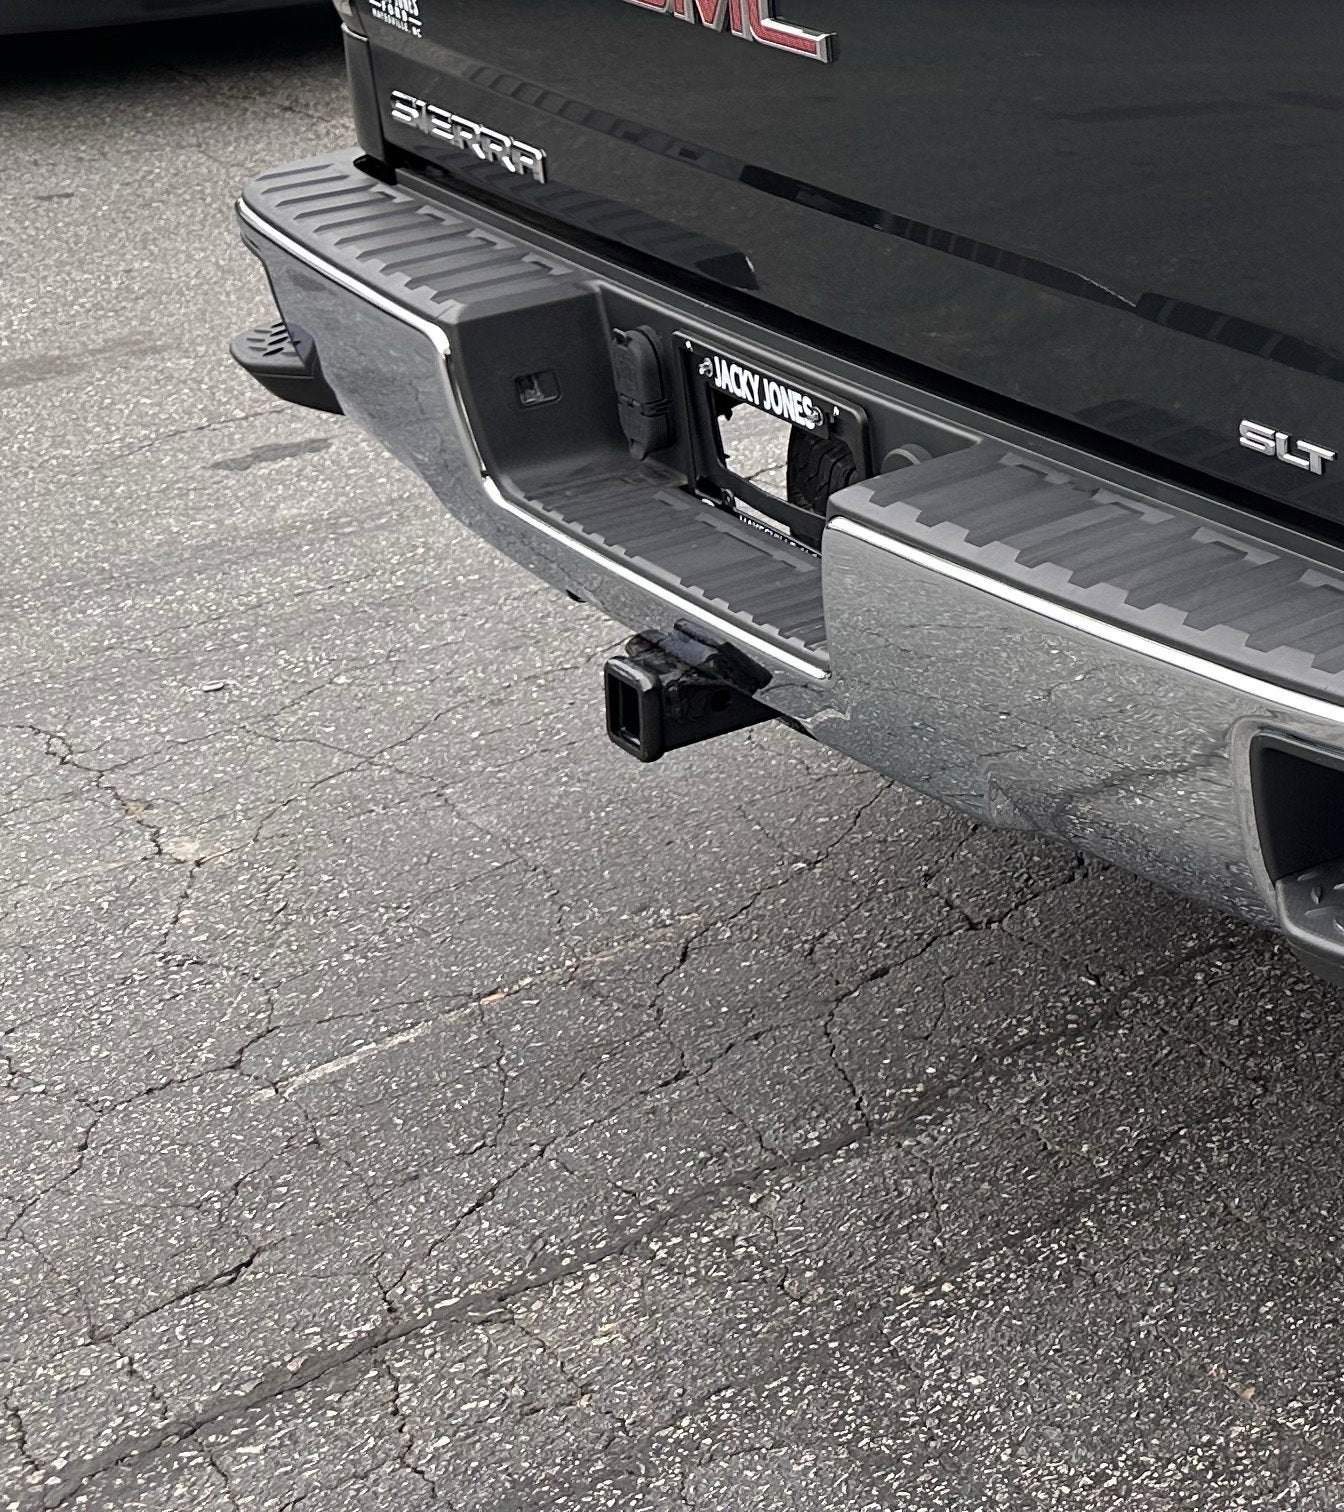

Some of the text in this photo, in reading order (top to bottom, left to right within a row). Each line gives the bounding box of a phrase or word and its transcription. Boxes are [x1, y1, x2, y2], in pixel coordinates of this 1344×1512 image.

[391, 90, 546, 184] SIERRA
[713, 356, 816, 430] JACKY JONES
[1239, 420, 1338, 475] SLT
